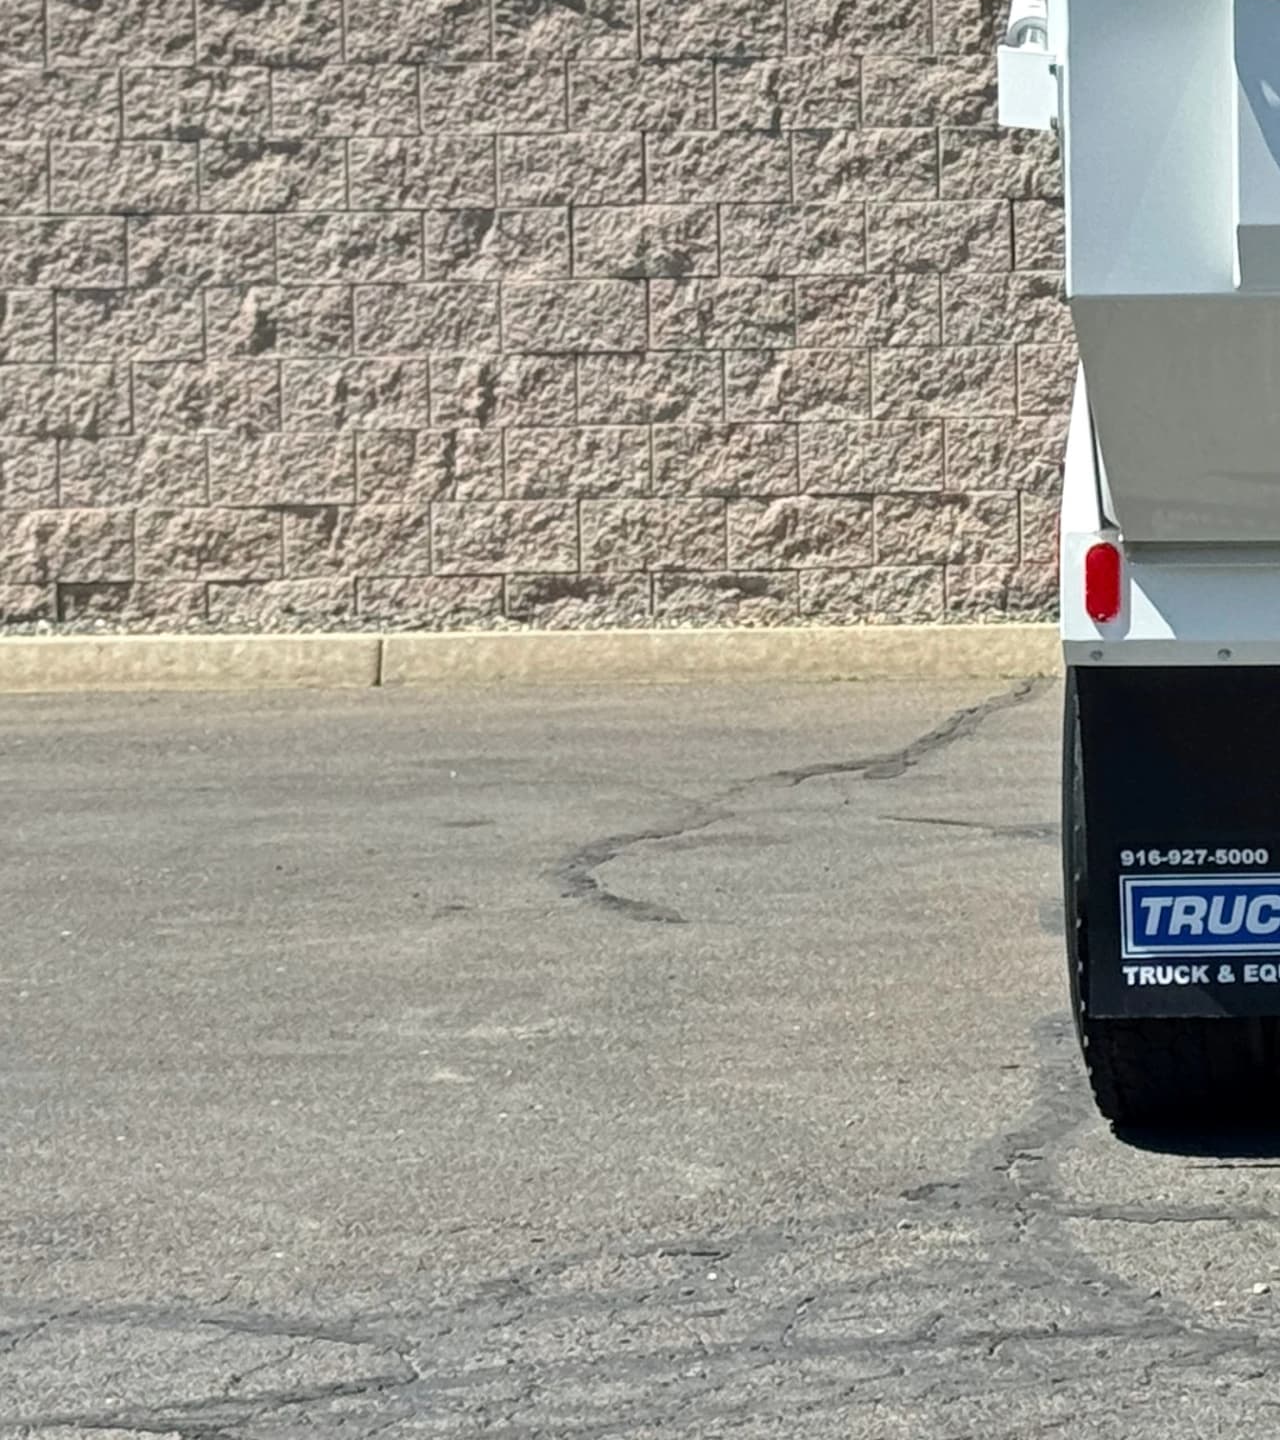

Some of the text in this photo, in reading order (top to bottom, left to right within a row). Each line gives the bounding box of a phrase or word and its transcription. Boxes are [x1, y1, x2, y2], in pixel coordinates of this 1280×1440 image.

[1120, 848, 1269, 866] 916-927-5000
[1123, 965, 1210, 985] TRUCK
[1217, 966, 1236, 983] &
